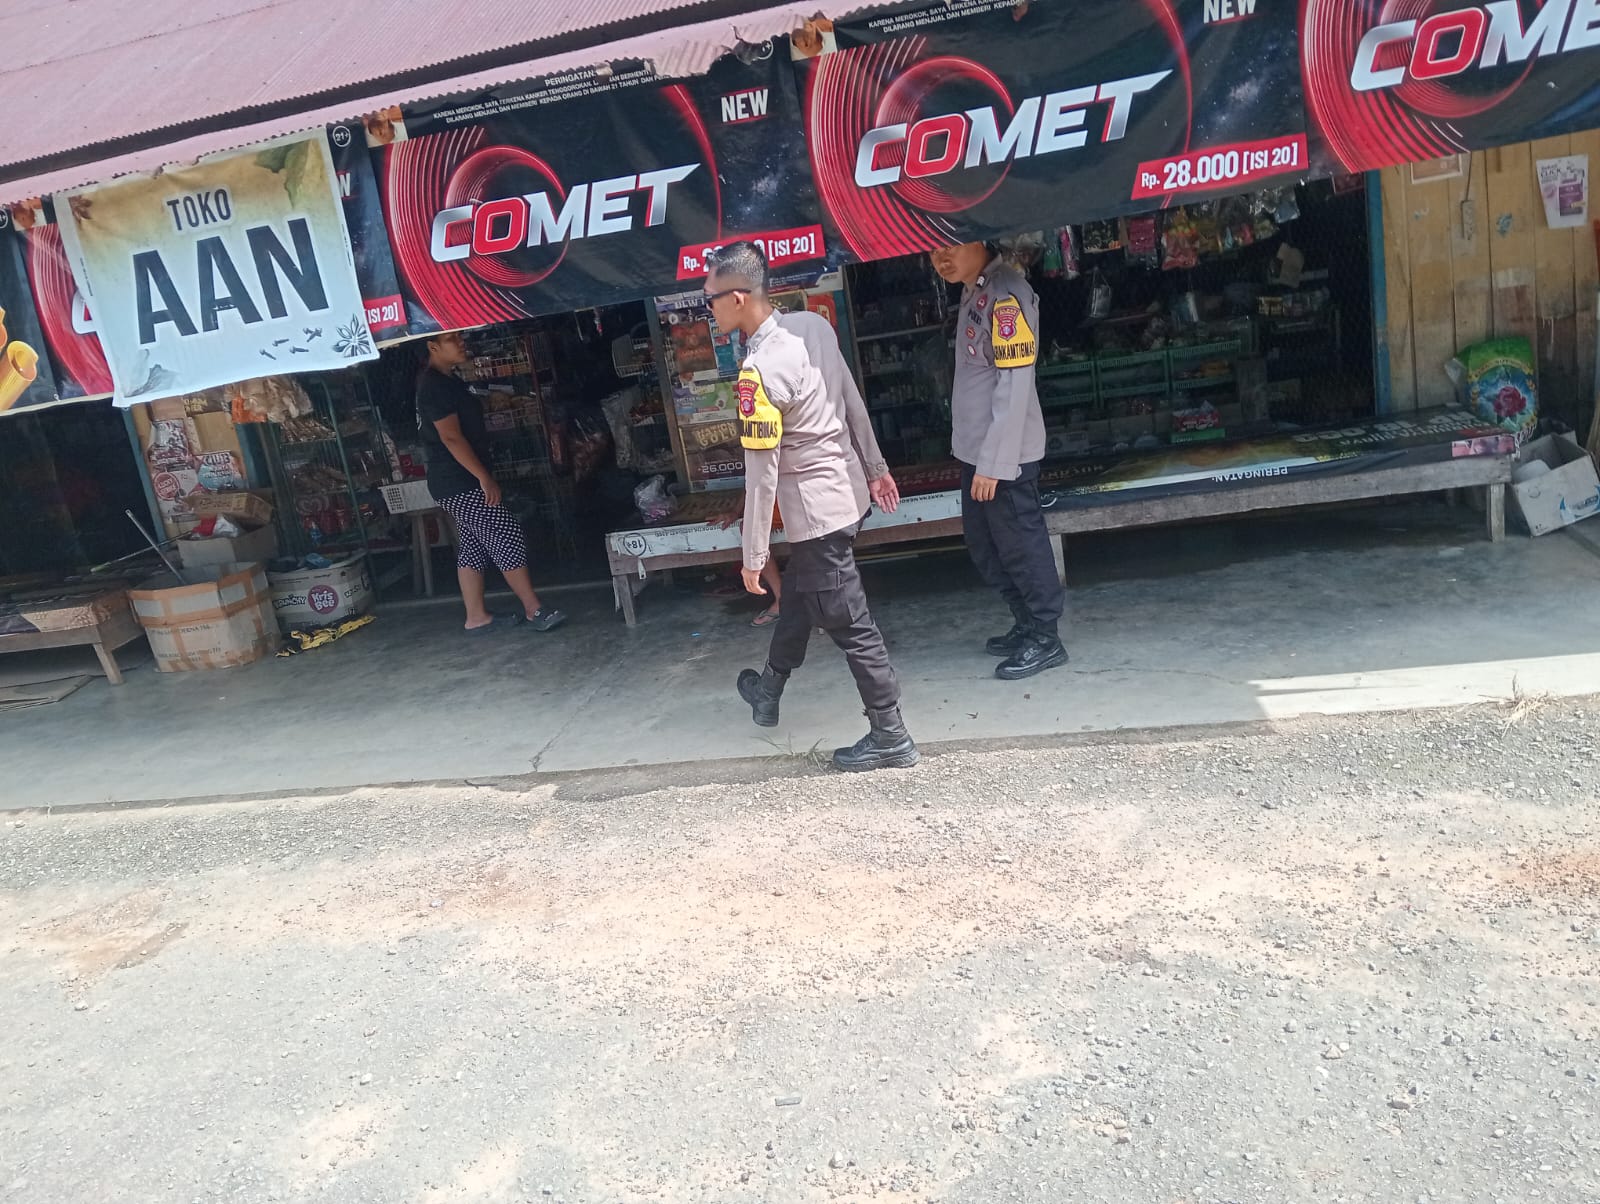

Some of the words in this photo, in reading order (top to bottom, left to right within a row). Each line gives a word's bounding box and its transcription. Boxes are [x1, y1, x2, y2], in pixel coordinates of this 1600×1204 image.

[868, 18, 895, 28] KARENA
[895, 12, 929, 23] MEROKOK,
[929, 7, 947, 16] SAYA
[883, 22, 915, 33] DILARANG
[915, 15, 946, 27] MENJUAL
[946, 11, 960, 20] DAN
[961, 5, 991, 16] MEMBERI
[1203, 0, 1256, 24] NEW
[433, 109, 456, 119] KARENA
[484, 100, 500, 109] SAYA
[499, 95, 525, 105] TERKENA
[525, 91, 548, 100] KANKER
[446, 114, 474, 124] DILARANG
[474, 108, 499, 118] MENJUAL
[499, 105, 511, 113] DAN
[511, 100, 538, 110] MEMBERI
[540, 94, 562, 105] KEPADA
[562, 90, 583, 100] ORANG
[583, 89, 590, 97] DI
[619, 78, 639, 89] TAHUN
[641, 75, 654, 83] DAN
[721, 88, 769, 123] NEW
[854, 69, 1174, 188] COMET
[1140, 169, 1161, 190] Rp.
[1163, 150, 1240, 190] 28.000
[1243, 149, 1269, 175] [ISI
[1270, 142, 1298, 169] 20]
[166, 188, 232, 231] TOKO
[430, 163, 700, 263] COMET
[683, 256, 701, 271] Rp.
[768, 237, 790, 261] [ISI
[792, 232, 815, 254] 20]
[133, 217, 330, 345] AAN
[381, 301, 399, 323] 20]
[699, 428, 737, 446] GOLD
[701, 461, 743, 474] 26.000
[626, 539, 643, 548] 18+
[311, 590, 334, 603] Kris
[315, 600, 335, 611] Bee
